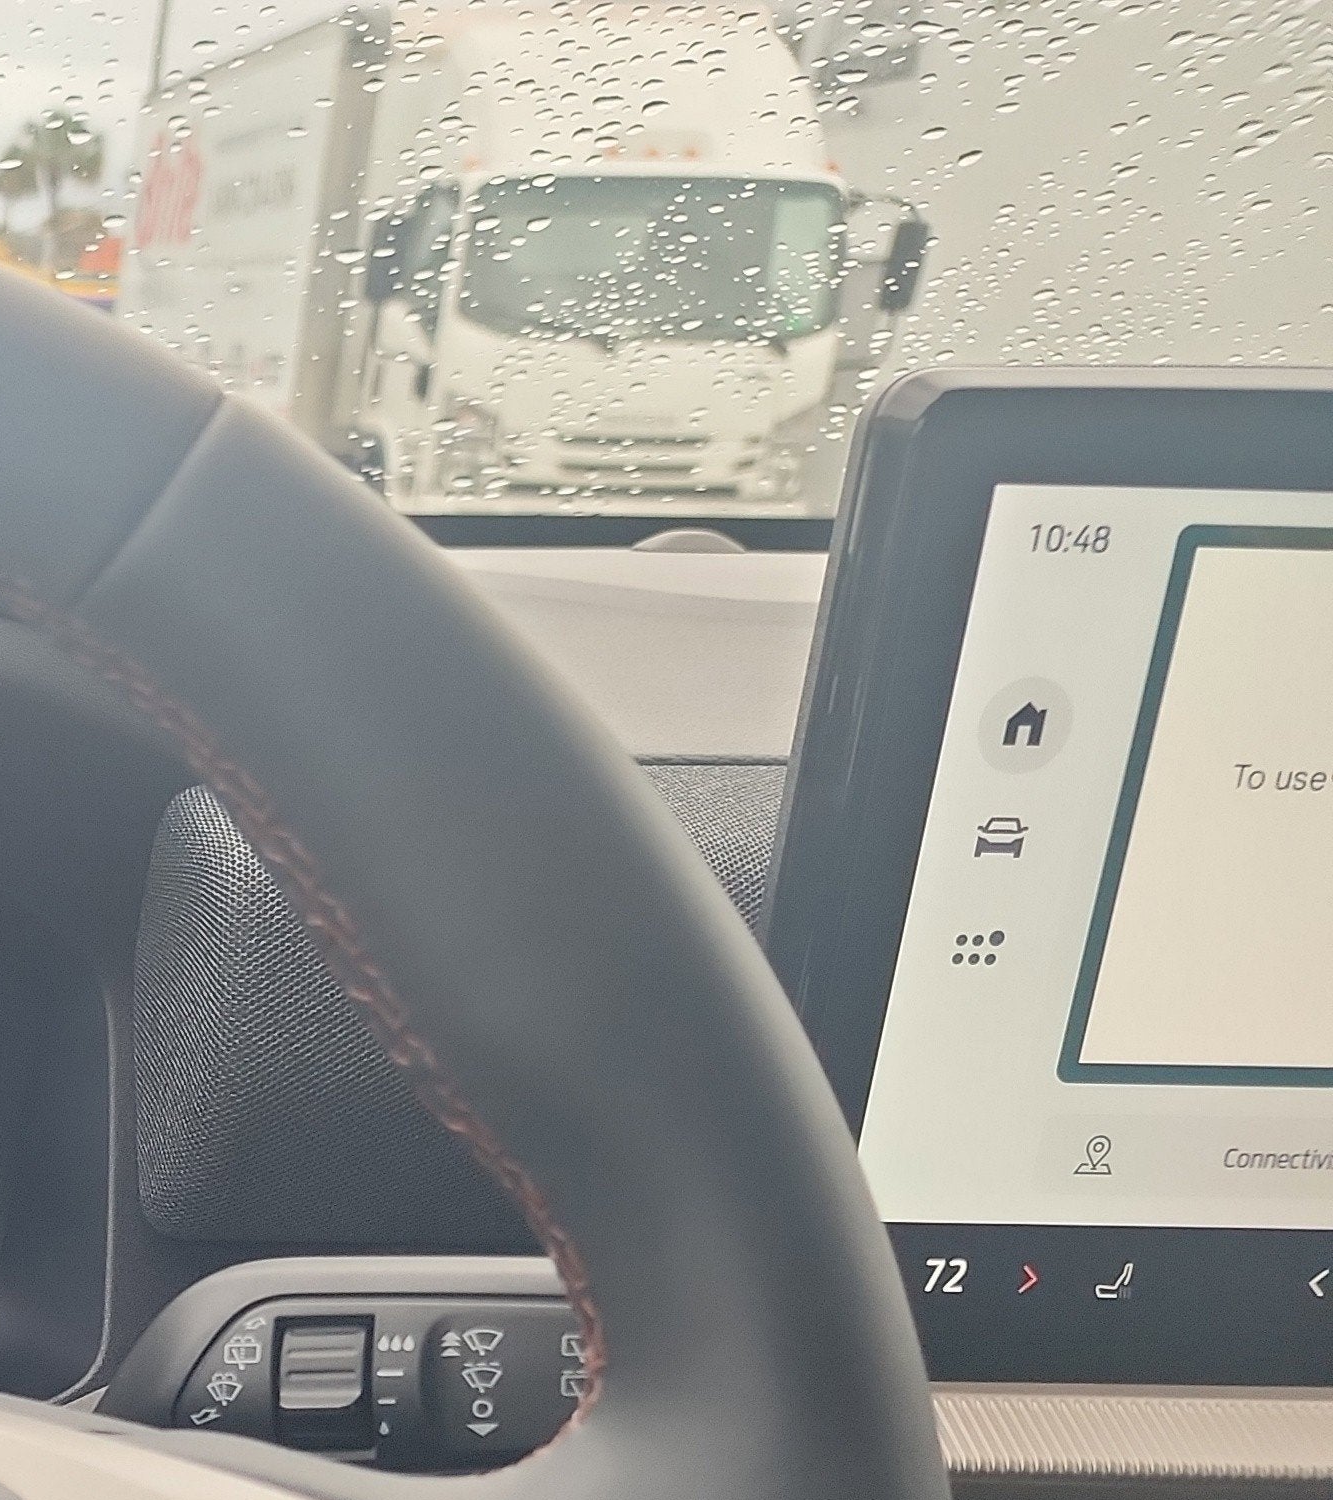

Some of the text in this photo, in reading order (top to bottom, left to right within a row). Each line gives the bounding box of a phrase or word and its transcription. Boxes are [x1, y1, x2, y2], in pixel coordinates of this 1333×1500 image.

[1031, 524, 1111, 554] 10:48
[1234, 764, 1327, 791] To use
[924, 1258, 968, 1293] 72
